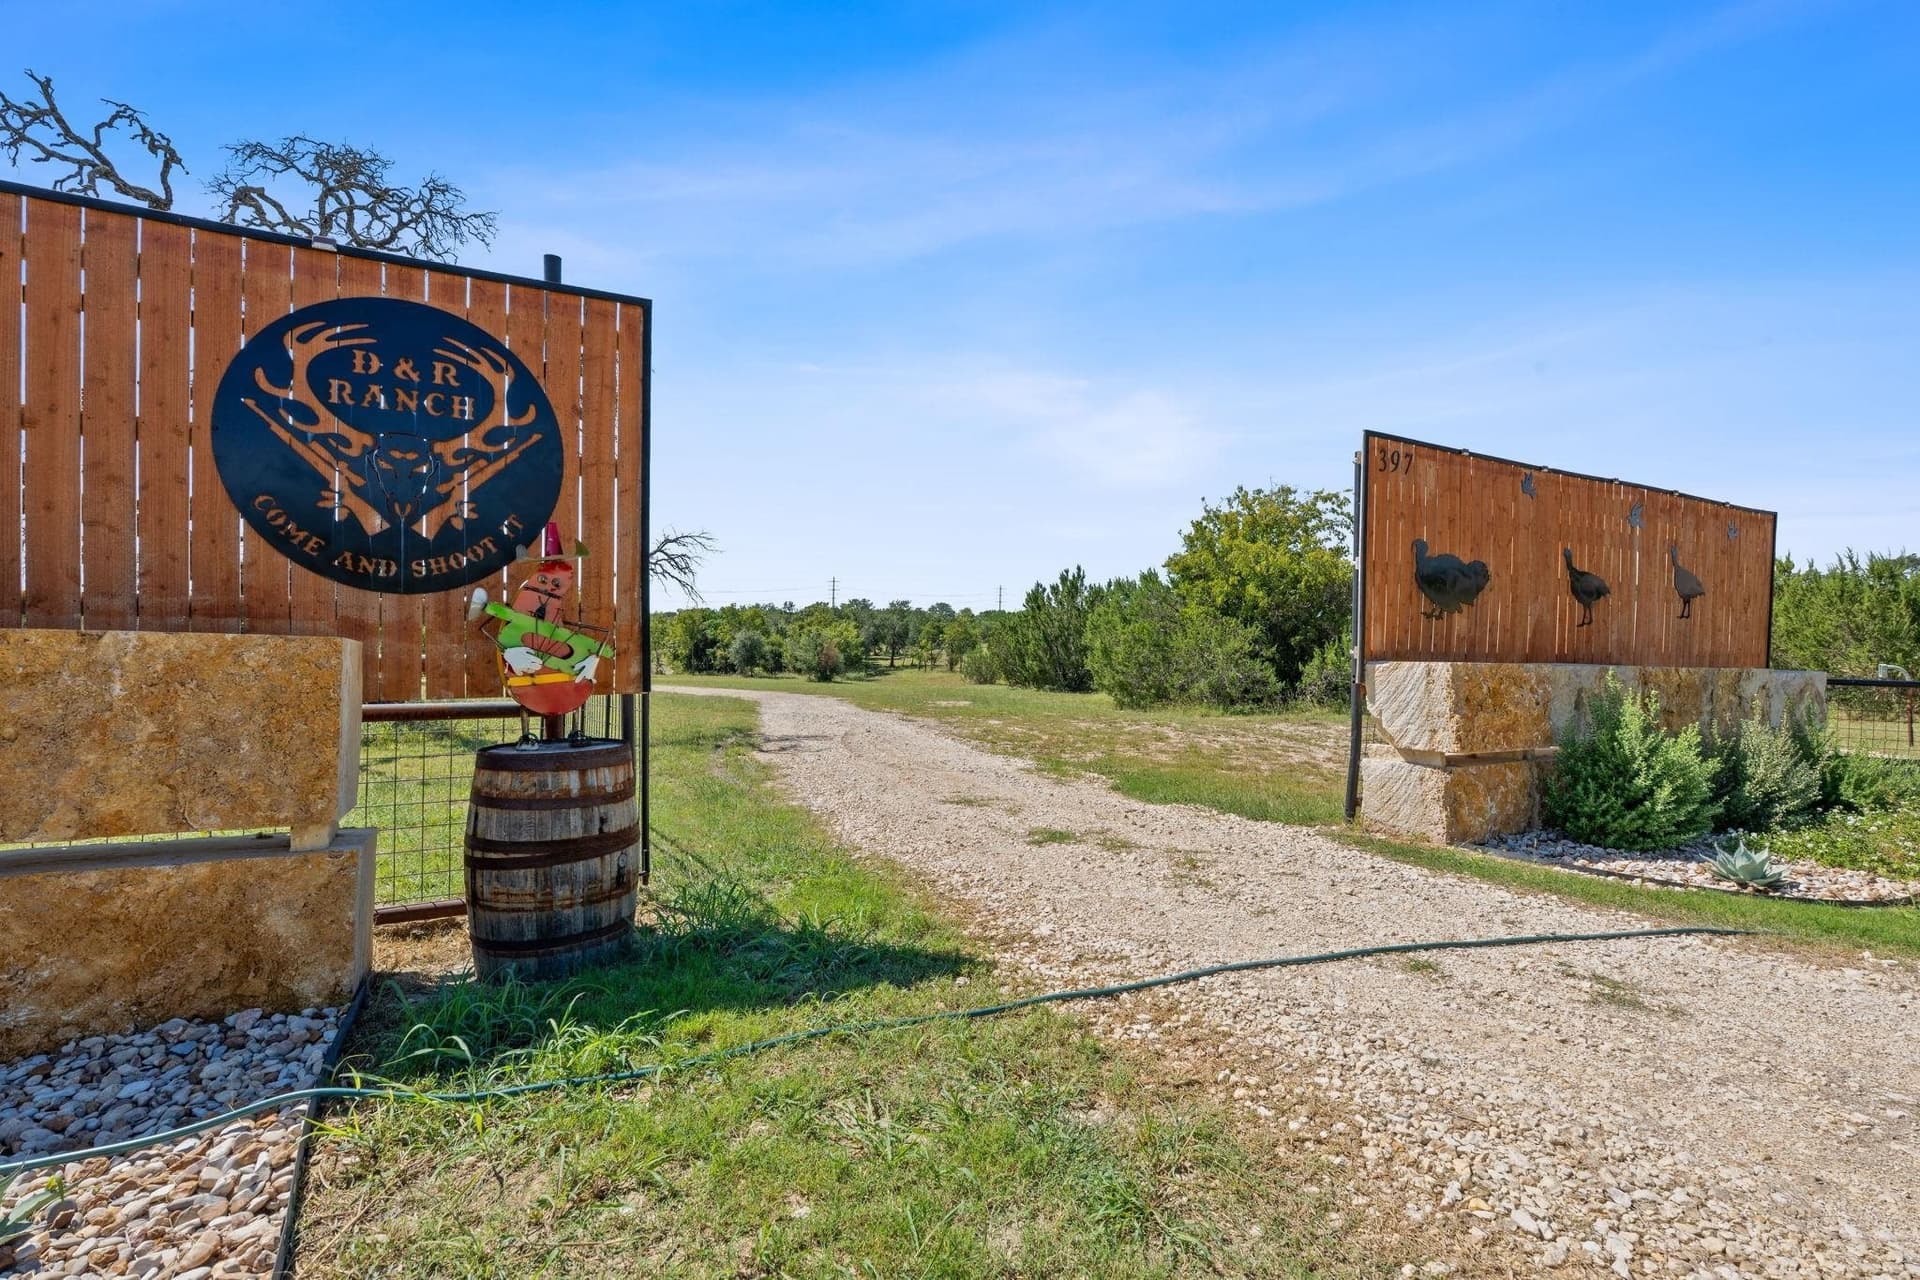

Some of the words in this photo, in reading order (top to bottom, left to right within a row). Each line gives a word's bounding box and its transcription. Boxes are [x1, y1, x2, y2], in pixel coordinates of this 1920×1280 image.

[352, 348, 381, 376] D
[394, 357, 421, 383] &
[432, 361, 462, 388] R
[328, 378, 476, 421] RANCH
[1378, 448, 1413, 475] 397
[253, 495, 325, 556] COME
[334, 550, 398, 579] AND
[411, 537, 500, 579] SHOOT
[499, 513, 525, 540] IT
